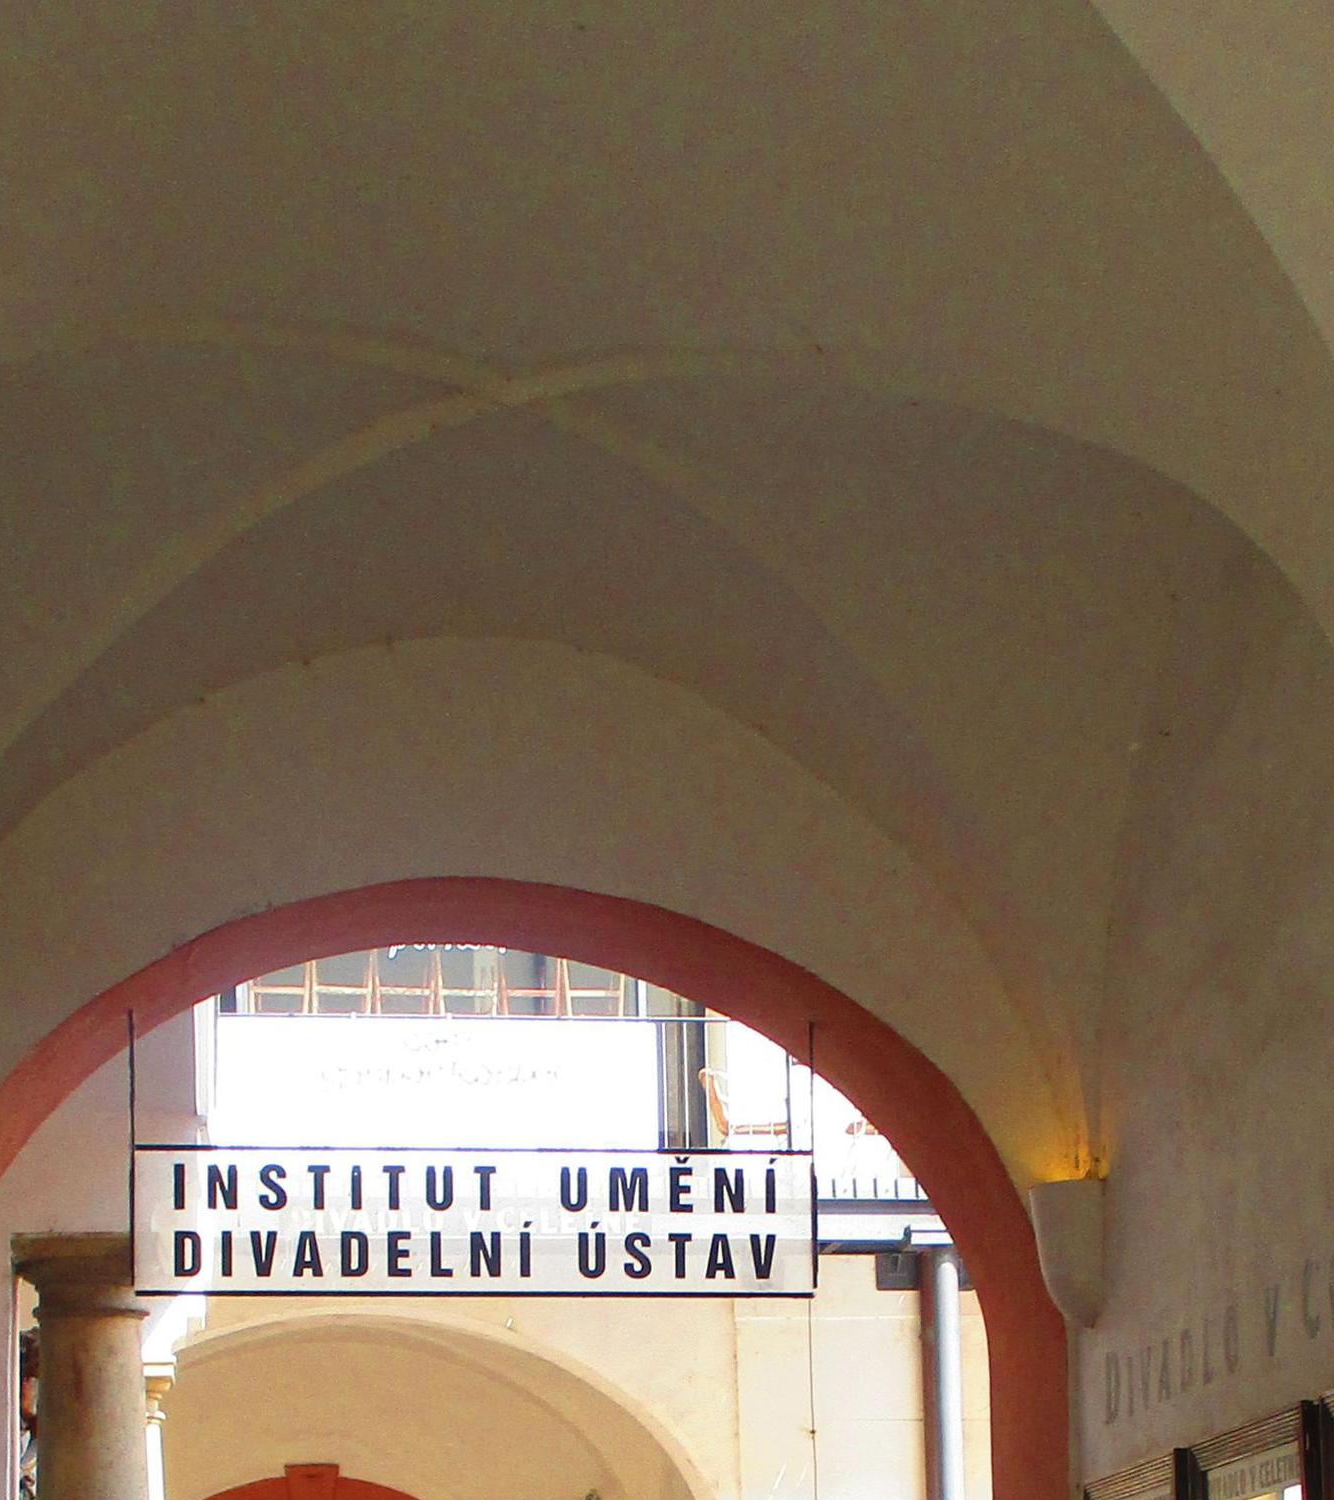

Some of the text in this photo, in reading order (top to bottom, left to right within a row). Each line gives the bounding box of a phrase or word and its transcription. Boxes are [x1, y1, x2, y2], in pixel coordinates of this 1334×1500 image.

[173, 1156, 779, 1215] INSTITUT UMĚNÍ
[173, 1220, 779, 1281] DIVADELNÍ ÚSTAV
[1104, 1302, 1240, 1426] DIVADLO
[1264, 1283, 1283, 1358] V
